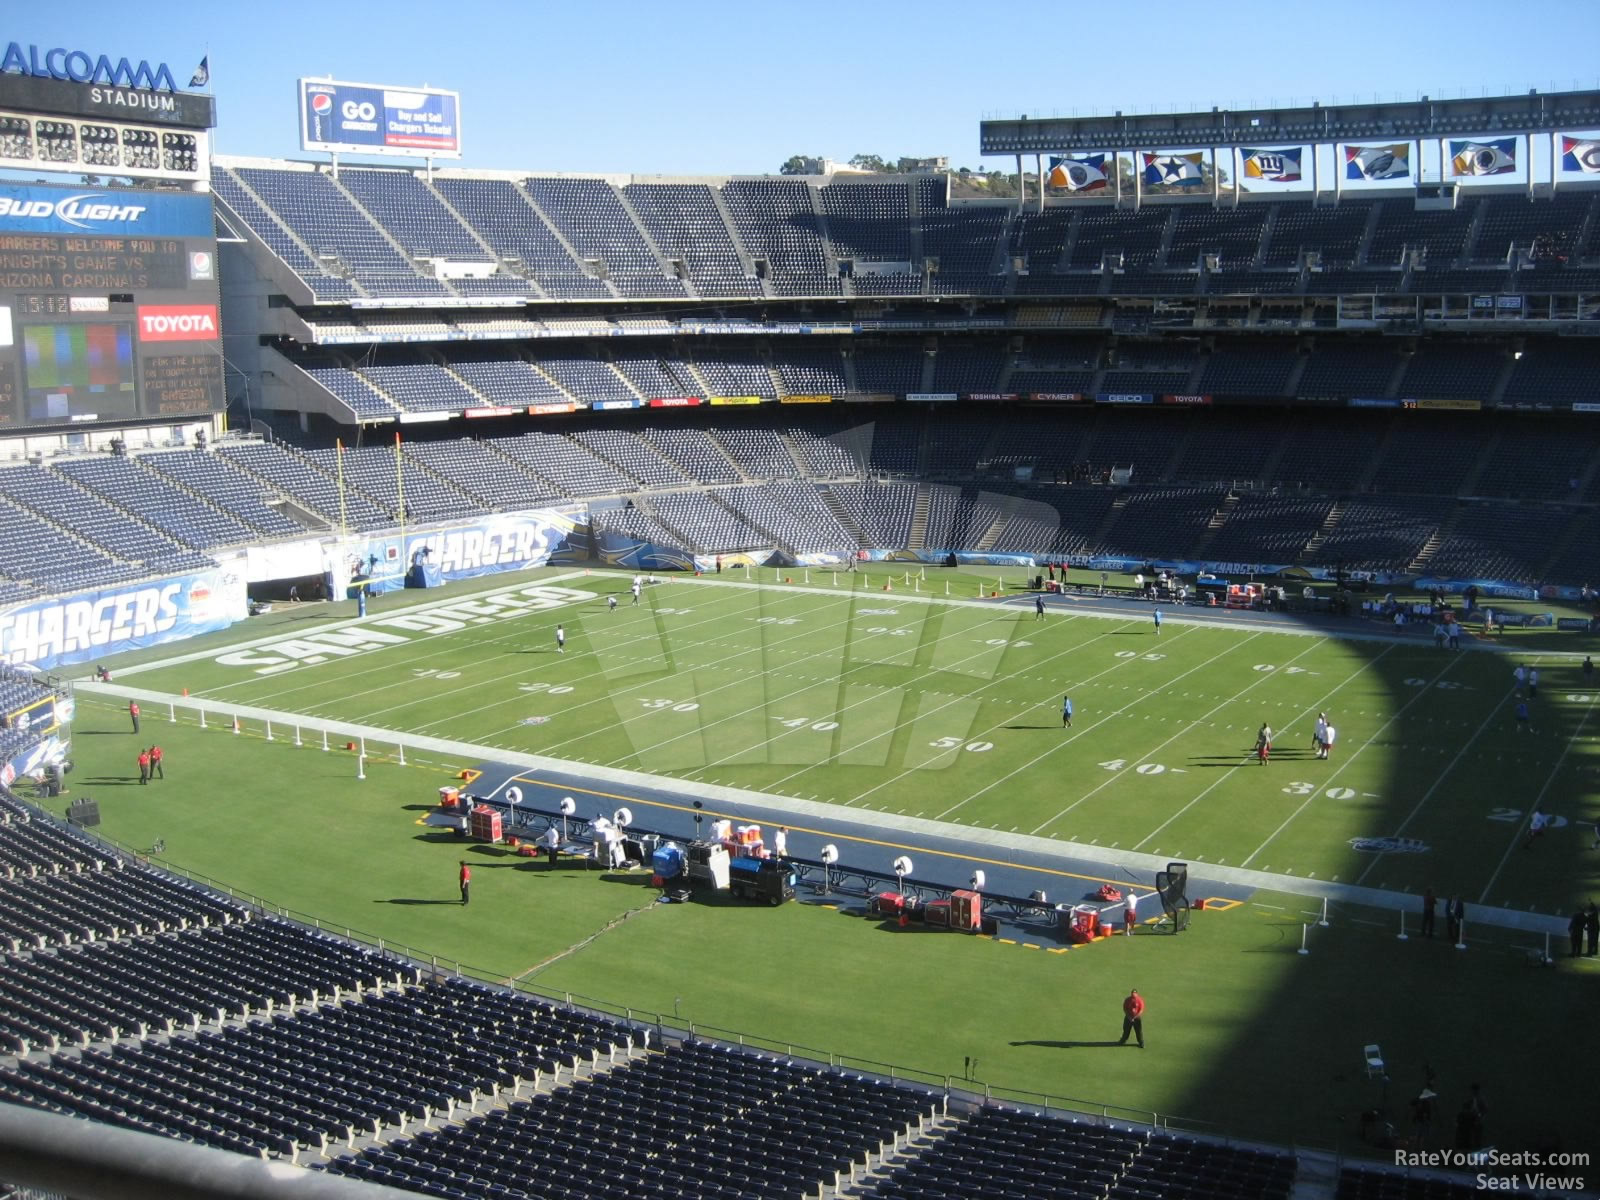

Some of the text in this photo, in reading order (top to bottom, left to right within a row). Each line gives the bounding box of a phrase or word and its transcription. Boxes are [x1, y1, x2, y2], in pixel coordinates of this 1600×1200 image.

[91, 87, 175, 111] STADIUM
[342, 100, 376, 121] GO
[398, 110, 442, 123] Buy and Sell
[389, 121, 422, 134] Chargers
[0, 197, 146, 221] BUD LIGHT
[65, 239, 124, 252] WELCOME
[131, 239, 156, 253] YOU
[0, 253, 67, 270] NIGHT'S
[73, 255, 117, 270] GAME
[61, 273, 148, 289] CARDINALS
[143, 315, 214, 333] TOYOTA
[409, 523, 550, 573] CHARGERS
[1214, 562, 1266, 574] CHARGERS
[0, 583, 182, 665] CHARGERS
[215, 586, 598, 676] SAN DIEGO
[928, 737, 994, 752] 50
[1098, 758, 1166, 775] 40
[1282, 781, 1355, 800] 30
